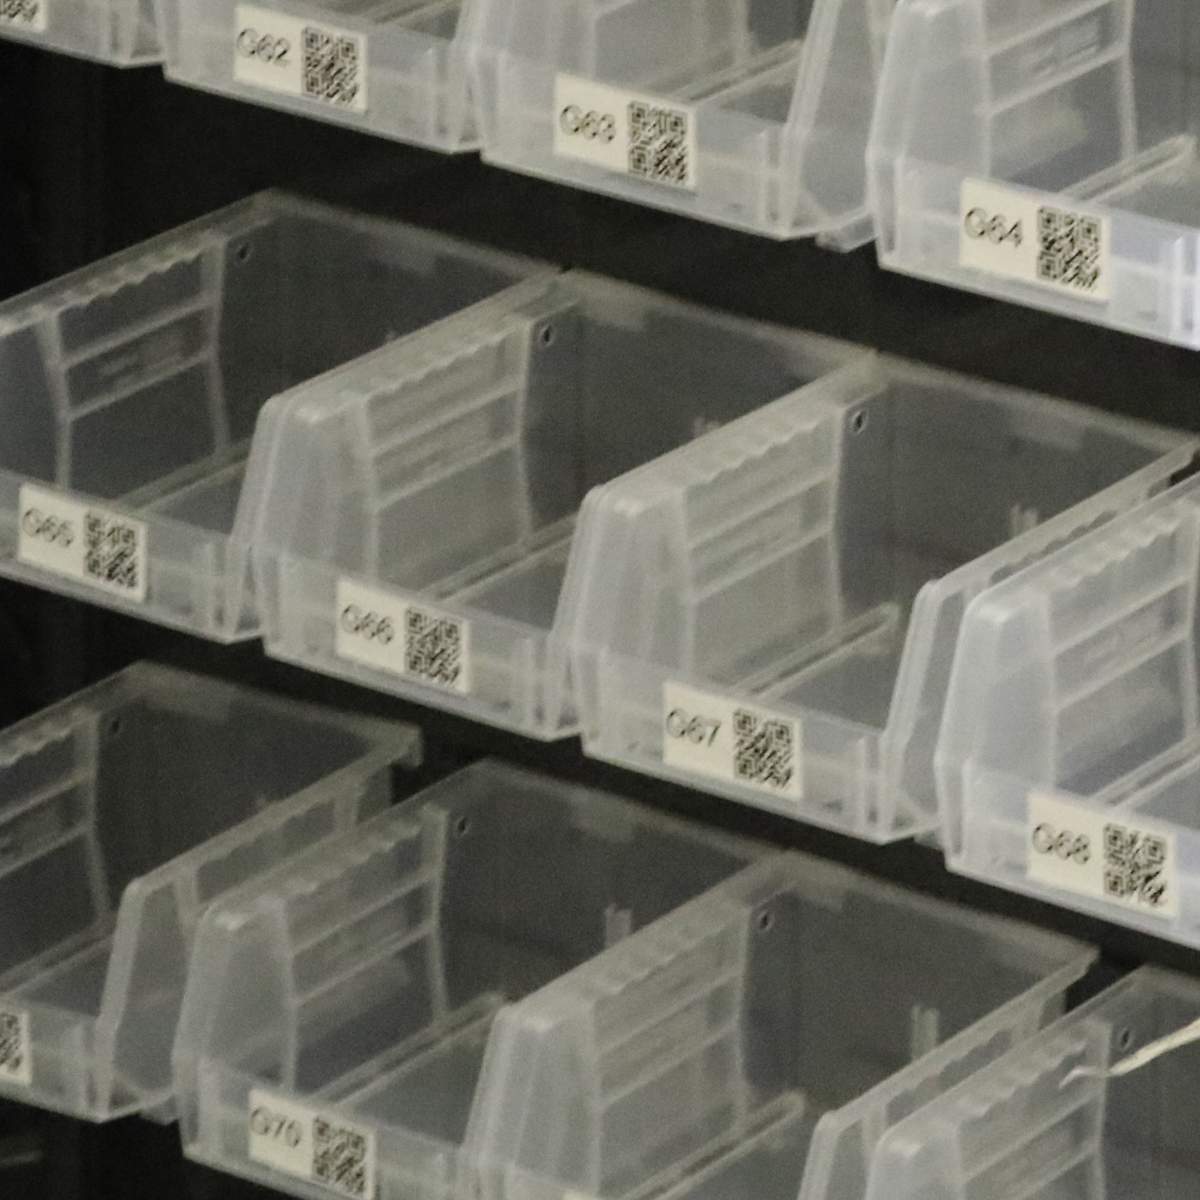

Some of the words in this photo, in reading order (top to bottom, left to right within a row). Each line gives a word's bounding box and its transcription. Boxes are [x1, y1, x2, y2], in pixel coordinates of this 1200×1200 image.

[237, 27, 291, 66] G62
[560, 103, 615, 143] G63
[964, 207, 1024, 249] G64
[340, 604, 393, 644] G66
[665, 708, 721, 746] G67
[1032, 822, 1091, 865] G68
[250, 1107, 301, 1147] G70
